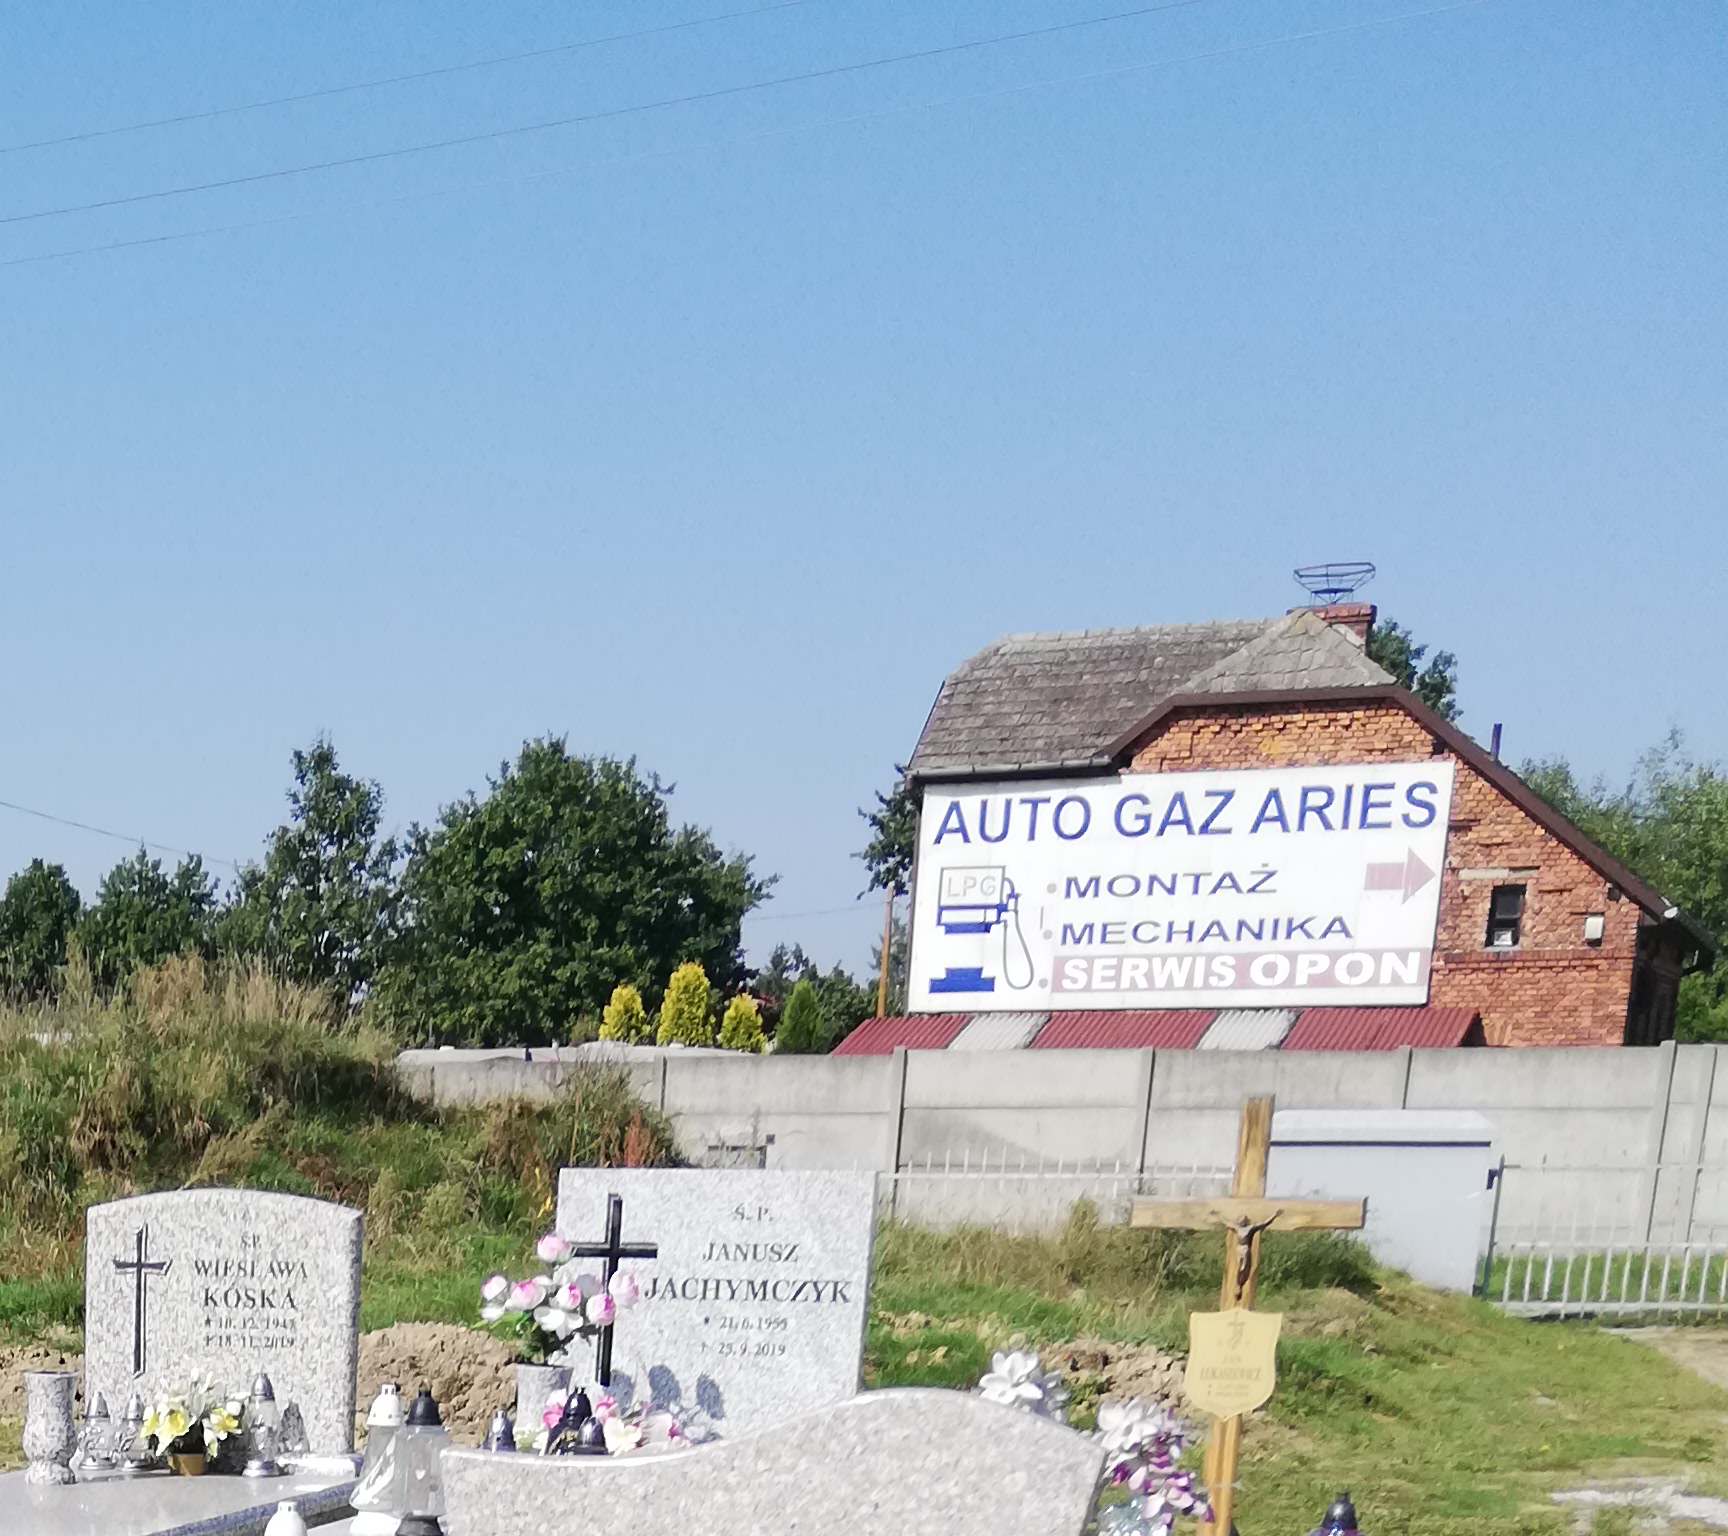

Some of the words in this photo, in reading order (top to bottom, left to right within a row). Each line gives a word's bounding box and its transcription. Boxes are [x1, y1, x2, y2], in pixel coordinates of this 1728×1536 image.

[933, 795, 1092, 845] AUTO
[1114, 789, 1236, 838] GAZ
[1249, 780, 1438, 835] ARIES
[947, 875, 997, 897] LPG
[1064, 863, 1278, 899] MONTAŻ
[1061, 915, 1354, 946] MECHANIKA
[1061, 955, 1238, 992] SERWIS
[1250, 949, 1422, 986] OPON
[702, 1242, 801, 1262] JANUSZ
[644, 1276, 852, 1304] JACHYMCZYK
